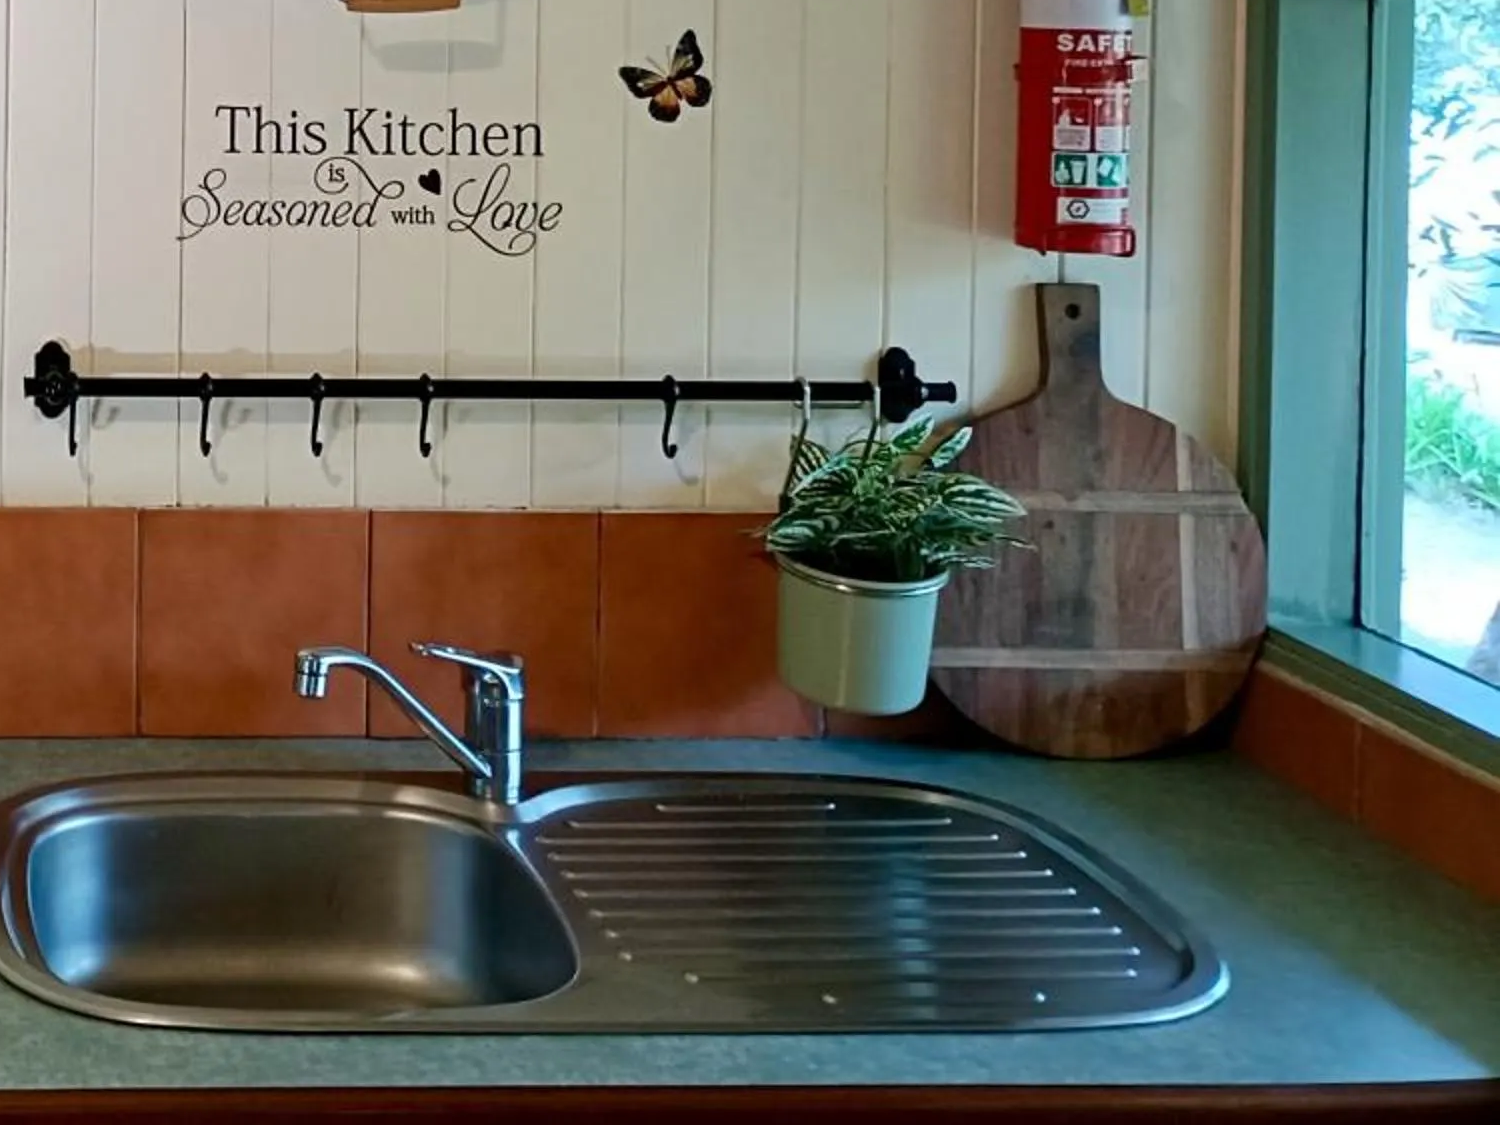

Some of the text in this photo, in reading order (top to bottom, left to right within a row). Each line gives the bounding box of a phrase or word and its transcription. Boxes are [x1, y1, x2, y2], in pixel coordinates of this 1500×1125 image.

[215, 105, 545, 158] This Kitchen
[327, 162, 346, 184] is
[176, 156, 563, 257] Seasoned with Love
